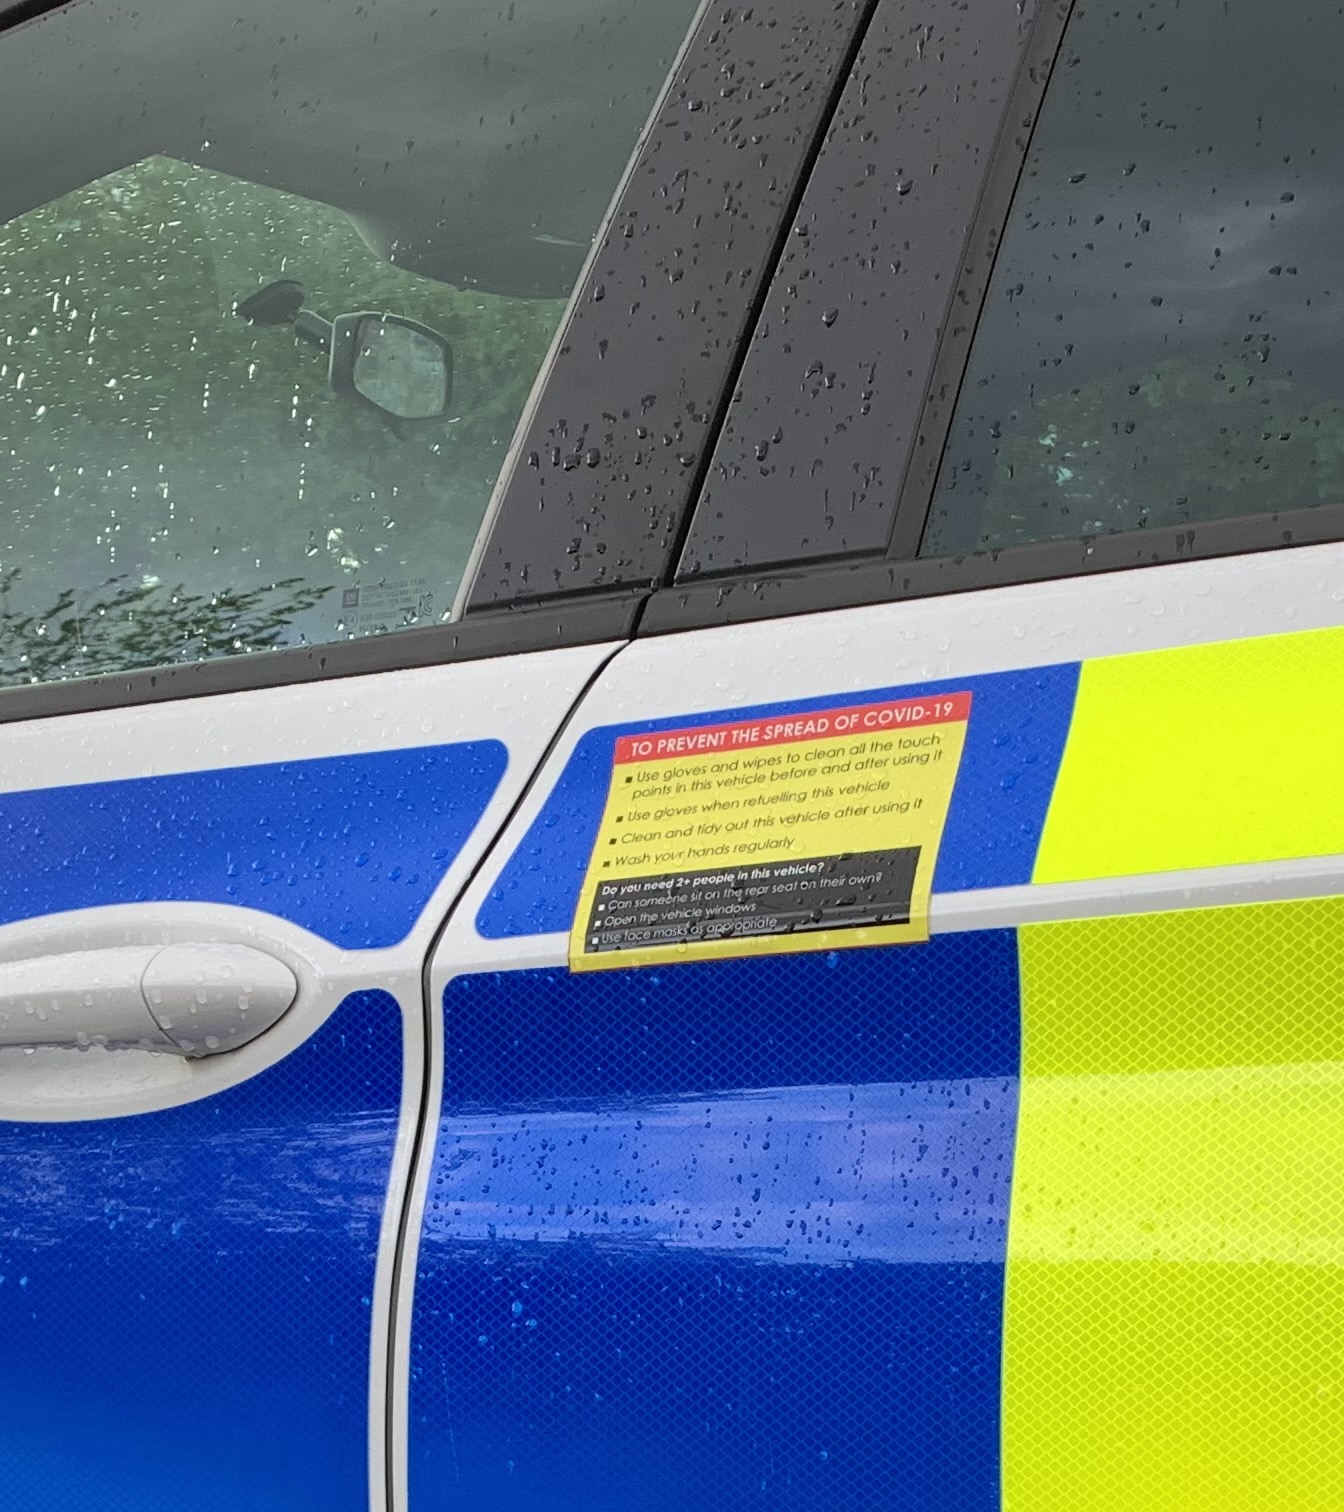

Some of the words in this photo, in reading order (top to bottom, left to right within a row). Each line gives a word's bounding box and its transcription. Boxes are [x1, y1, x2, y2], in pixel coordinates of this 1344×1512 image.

[631, 741, 652, 757] TO
[657, 731, 727, 754] PREVENT
[731, 727, 760, 744] THE
[763, 717, 829, 740] SPREAD
[835, 713, 859, 730] OF
[864, 701, 953, 727] COVID-19
[632, 784, 672, 801] points
[675, 781, 687, 793] in
[691, 778, 712, 791] this
[717, 772, 766, 788] vehicle
[770, 766, 817, 782] before
[821, 759, 851, 774] and
[854, 755, 889, 770] after
[893, 751, 930, 766] using
[933, 749, 943, 761] it
[637, 771, 660, 783] Use
[663, 765, 707, 782] gloves
[711, 759, 739, 773] and
[743, 754, 782, 770] wipes
[786, 753, 800, 764] to
[804, 747, 845, 762] clean
[849, 743, 866, 755] all
[870, 739, 893, 752] the
[898, 733, 940, 749] touch
[621, 829, 661, 844] Clean
[665, 825, 693, 839] and
[697, 821, 722, 835] tidy
[725, 819, 749, 831] out
[753, 815, 775, 828] this
[779, 808, 830, 825] vehicle
[834, 805, 869, 819] after
[872, 800, 910, 814] using
[913, 797, 923, 809] it
[627, 810, 651, 822] Use
[654, 804, 698, 820] gloves
[702, 797, 739, 812] when
[743, 790, 807, 809] refuelling
[812, 785, 834, 798] this
[839, 779, 890, 795] vehicle
[615, 853, 651, 866] Wash
[654, 851, 685, 865] your
[687, 844, 730, 858] hands
[733, 836, 795, 854] regularly
[602, 885, 618, 896] Do
[620, 884, 641, 896] you
[643, 879, 674, 891] need
[676, 877, 690, 888] 2+
[693, 873, 735, 888] people
[737, 870, 748, 880] in
[750, 868, 771, 879] this
[774, 862, 825, 877] vehicle?
